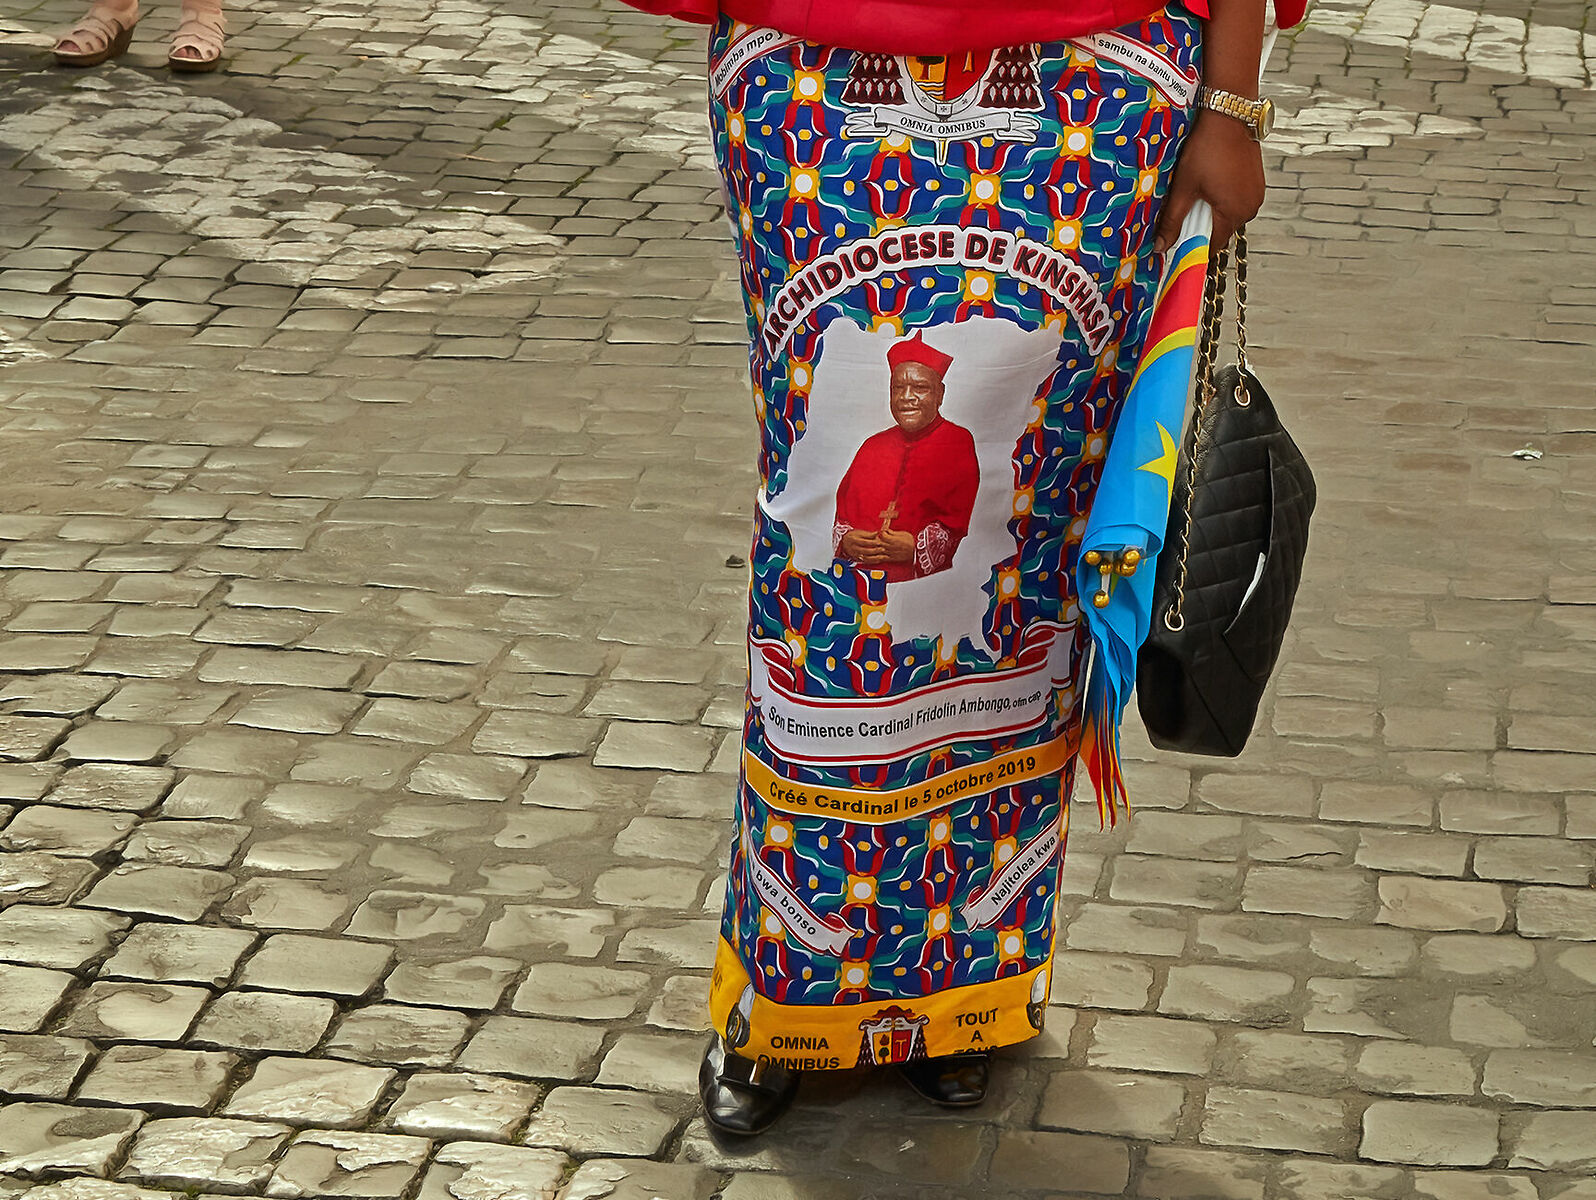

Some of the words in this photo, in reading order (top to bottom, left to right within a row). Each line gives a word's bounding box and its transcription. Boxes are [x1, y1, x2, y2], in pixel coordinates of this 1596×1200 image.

[746, 31, 774, 53] mpo
[1098, 39, 1134, 60] sambu
[1136, 53, 1148, 67] na
[1148, 59, 1172, 81] bantu
[900, 116, 934, 134] OMNIA
[938, 119, 986, 135] OMNIBUS
[763, 231, 955, 351] ARCHIDIOCESE
[963, 233, 1009, 265] DE
[1013, 245, 1111, 351] KINSHASA
[768, 706, 786, 731] Son
[787, 717, 855, 738] Eminence
[858, 712, 914, 738] Cardinal
[916, 702, 956, 726] Fridolin
[958, 696, 1011, 715] Ambongo,
[1012, 696, 1027, 708] ofm
[1028, 690, 1042, 704] cap
[769, 781, 808, 806] Créé
[814, 794, 899, 816] Cardinal
[904, 795, 918, 811] le
[923, 789, 932, 803] 5
[935, 772, 994, 801] octobre
[997, 756, 1037, 780] 2019
[991, 856, 1036, 906] Najitolea
[1034, 836, 1056, 859] kwa
[755, 870, 779, 898] bwa
[780, 896, 817, 936] bonso
[955, 1008, 999, 1027] TOUT
[770, 1036, 830, 1050] OMNIA
[970, 1029, 983, 1043] A
[757, 1053, 841, 1071] OMNIBUS
